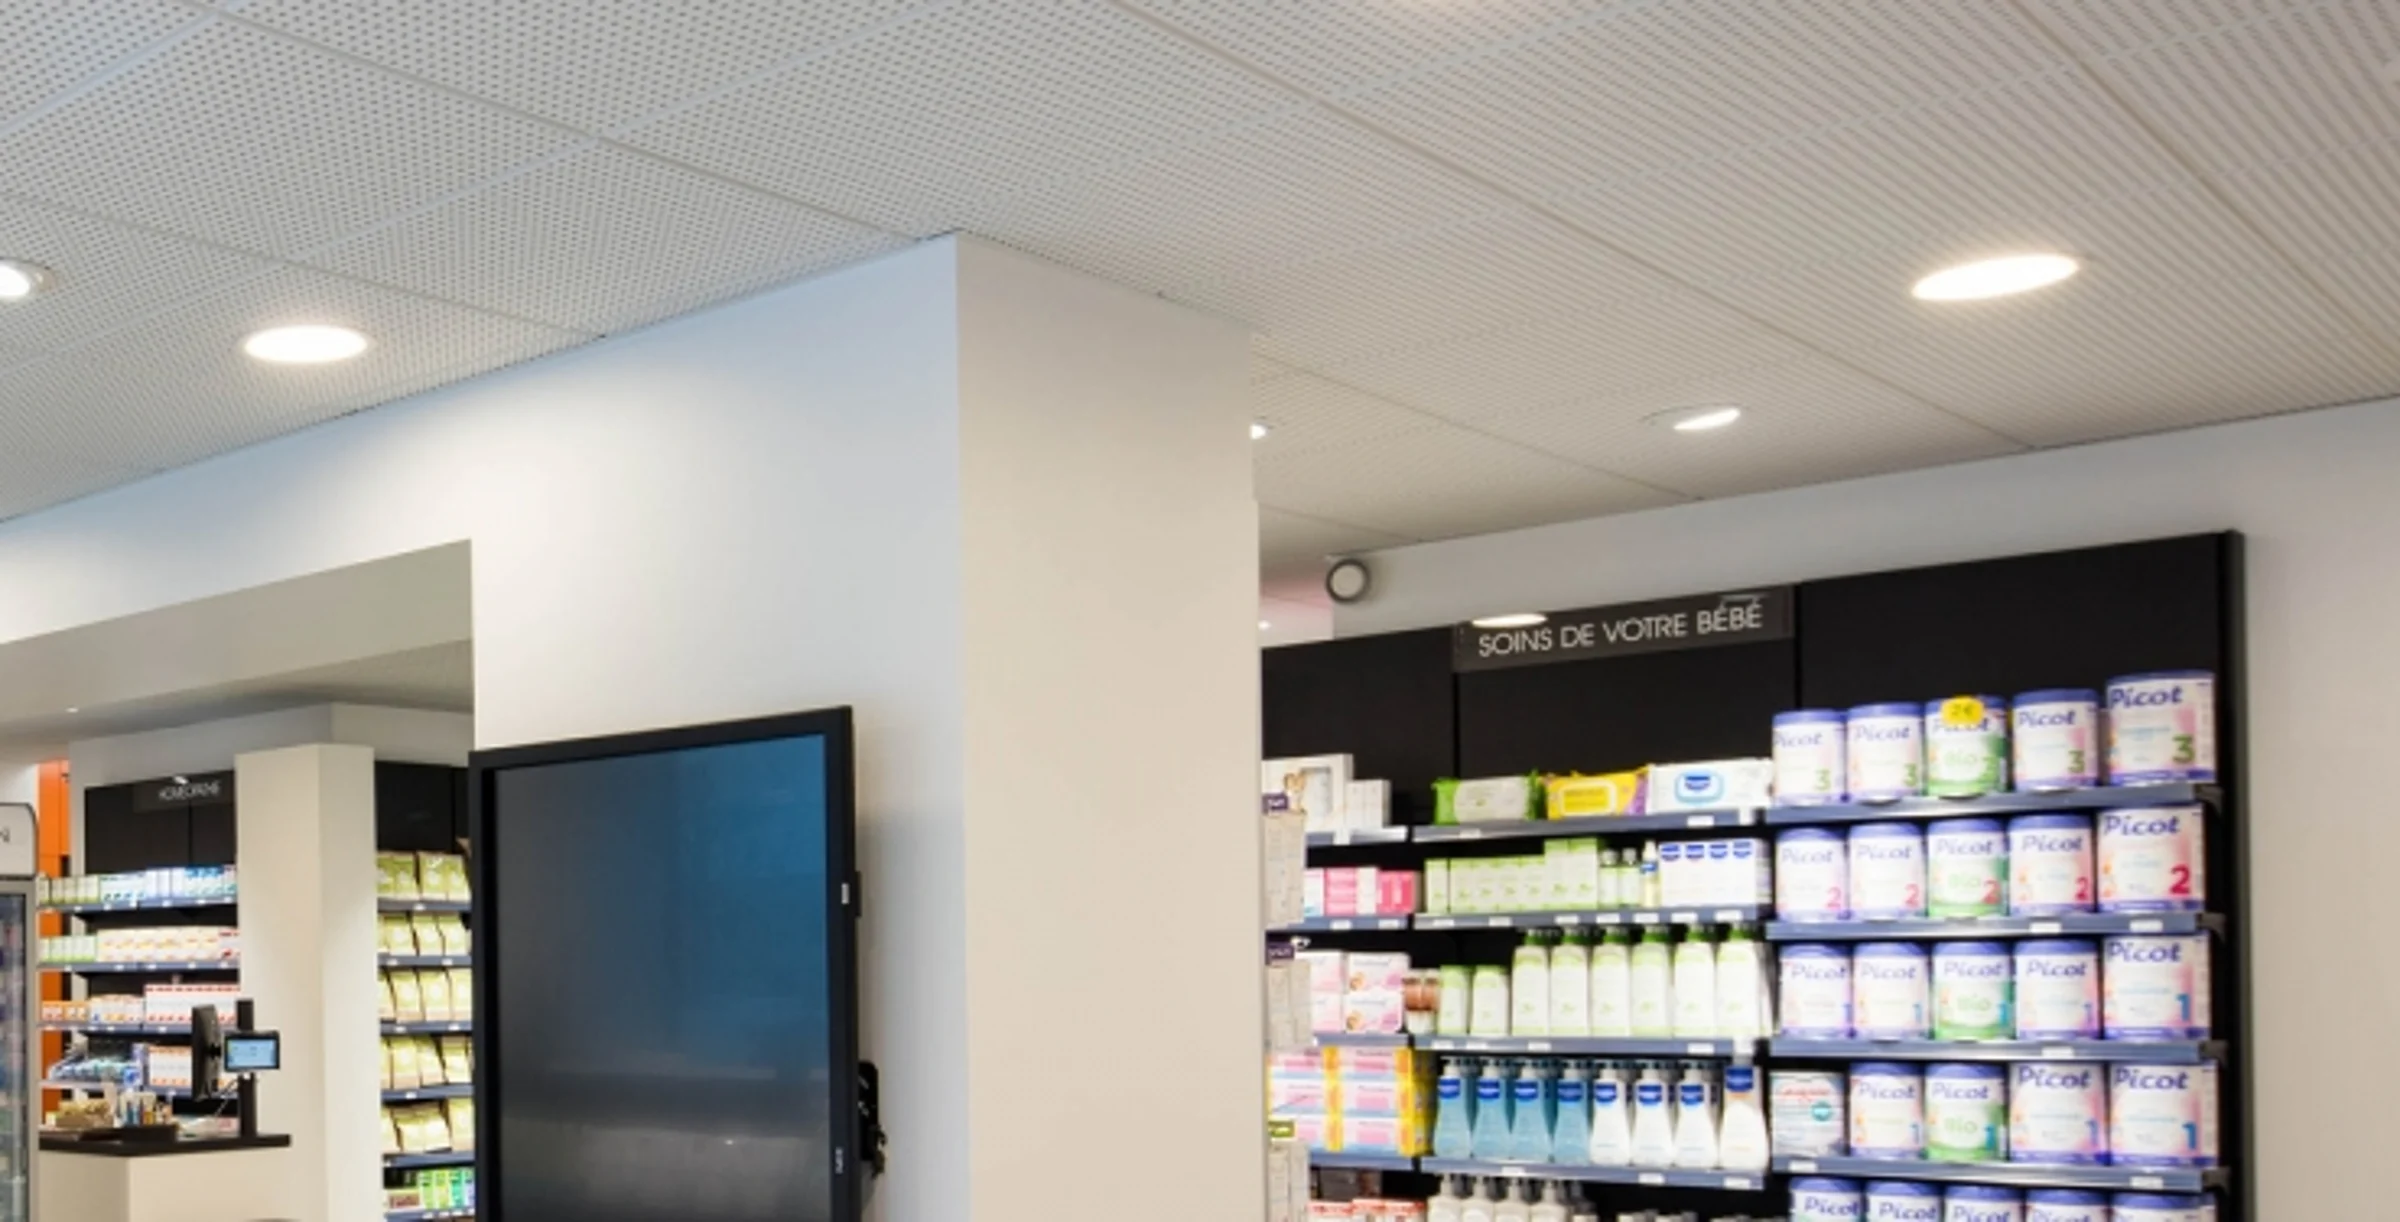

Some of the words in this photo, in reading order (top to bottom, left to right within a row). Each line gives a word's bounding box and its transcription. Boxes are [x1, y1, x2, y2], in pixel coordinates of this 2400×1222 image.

[1478, 628, 1552, 658] SOINS
[1560, 624, 1595, 648] DE
[1602, 613, 1688, 643] VOTRE
[1696, 601, 1764, 635] BÉBÉ
[2109, 685, 2183, 707] Picot
[2019, 710, 2076, 726] Picot
[1854, 724, 1911, 742] Picot
[2172, 734, 2195, 763] 3
[2068, 750, 2085, 774] 3
[1815, 769, 1831, 791] 3
[1904, 763, 1918, 786] 3
[2102, 814, 2180, 835] Picot
[1858, 844, 1912, 860] Picot
[1937, 838, 1993, 855] Picot
[2021, 834, 2083, 851] Picot
[2074, 876, 2089, 900] 2
[2169, 863, 2191, 894] 2
[1826, 887, 1842, 909] 2
[1905, 883, 1919, 907] 2
[1982, 879, 2001, 905] 2
[2107, 941, 2182, 962] Picot
[1791, 962, 1847, 979] Picot
[1861, 962, 1917, 979] Picot
[1943, 960, 2003, 977] Picot
[2026, 959, 2088, 977] Picot
[1912, 1003, 1923, 1023] 1
[1997, 1000, 2009, 1027] 1
[2176, 993, 2191, 1021] 1
[2018, 1064, 2091, 1088] Picot
[2114, 1067, 2188, 1089] Picot
[1859, 1083, 1916, 1100] Picot
[1932, 1082, 1990, 1099] Picot
[1909, 1123, 1921, 1145] 1
[1984, 1123, 1996, 1150] 1
[2086, 1119, 2099, 1147] 1
[2182, 1121, 2197, 1150] 1
[1879, 1202, 1938, 1220] Picot
